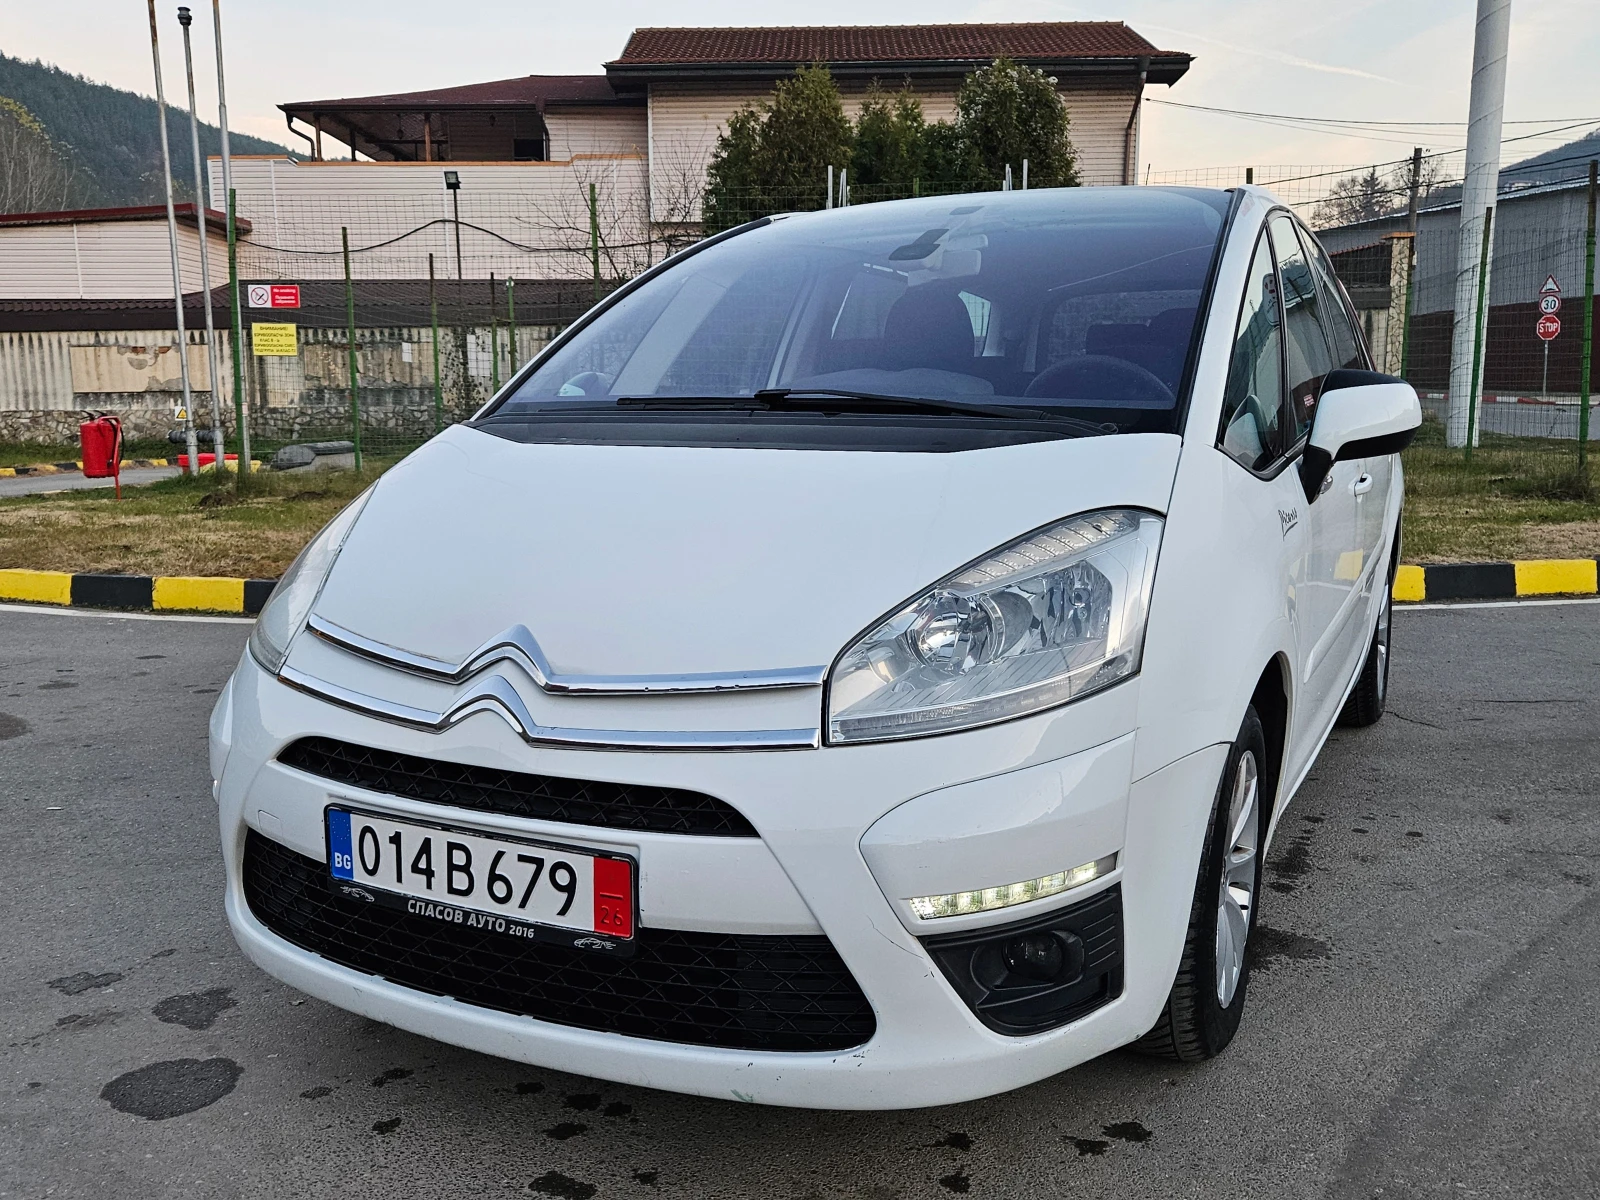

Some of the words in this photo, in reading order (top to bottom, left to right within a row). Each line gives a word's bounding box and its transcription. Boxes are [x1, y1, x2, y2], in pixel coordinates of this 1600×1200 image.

[1543, 299, 1557, 310] 30
[1539, 322, 1559, 333] STOP
[334, 852, 352, 870] BG
[407, 899, 464, 924] СПАСОВ
[467, 914, 506, 933] АУТО
[509, 924, 535, 939] 2016
[601, 905, 624, 927] 26
